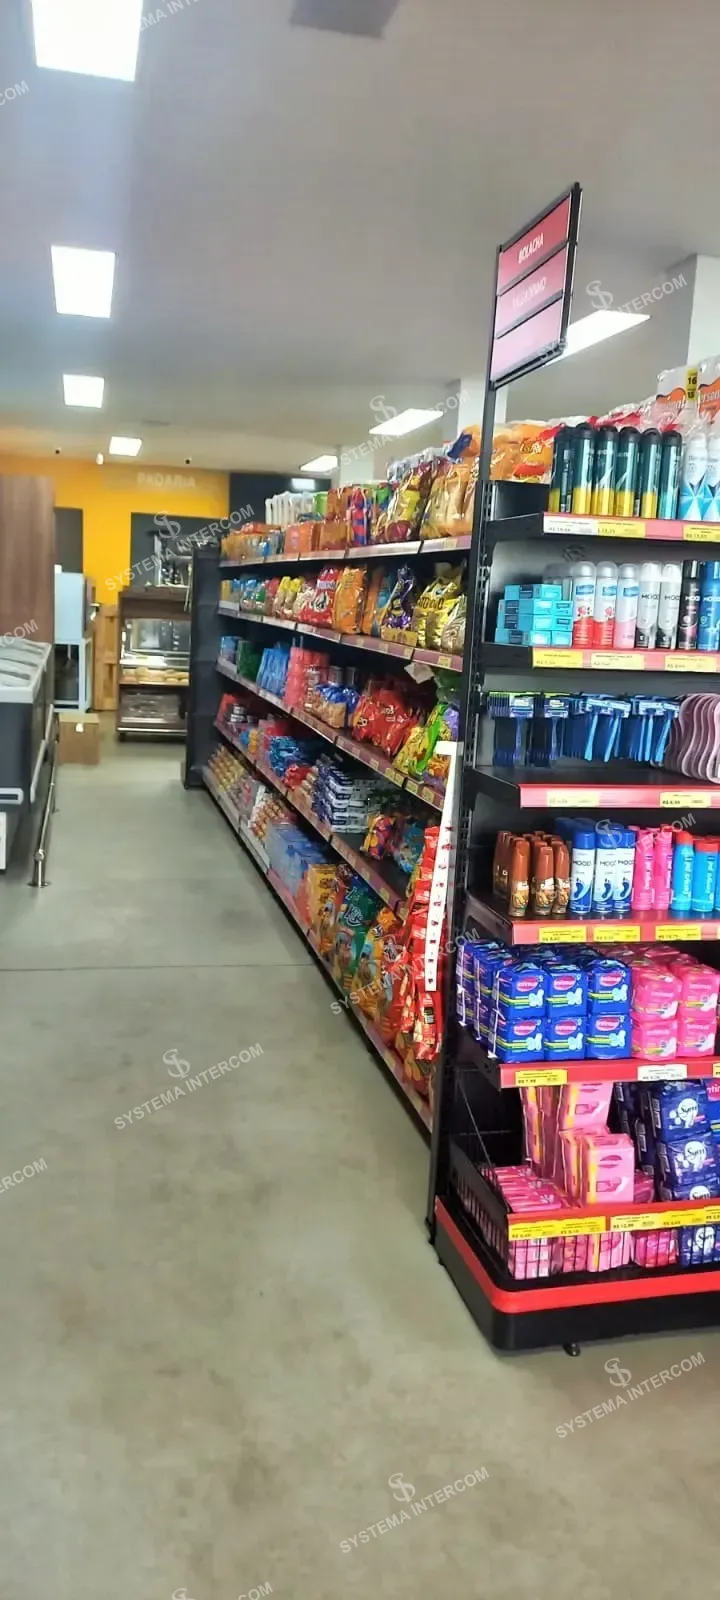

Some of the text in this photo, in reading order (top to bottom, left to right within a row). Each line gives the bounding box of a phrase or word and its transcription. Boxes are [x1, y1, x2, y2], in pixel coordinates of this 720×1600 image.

[518, 233, 545, 264] BOLACHA
[687, 377, 697, 385] 16
[136, 471, 197, 488] PADARIA
